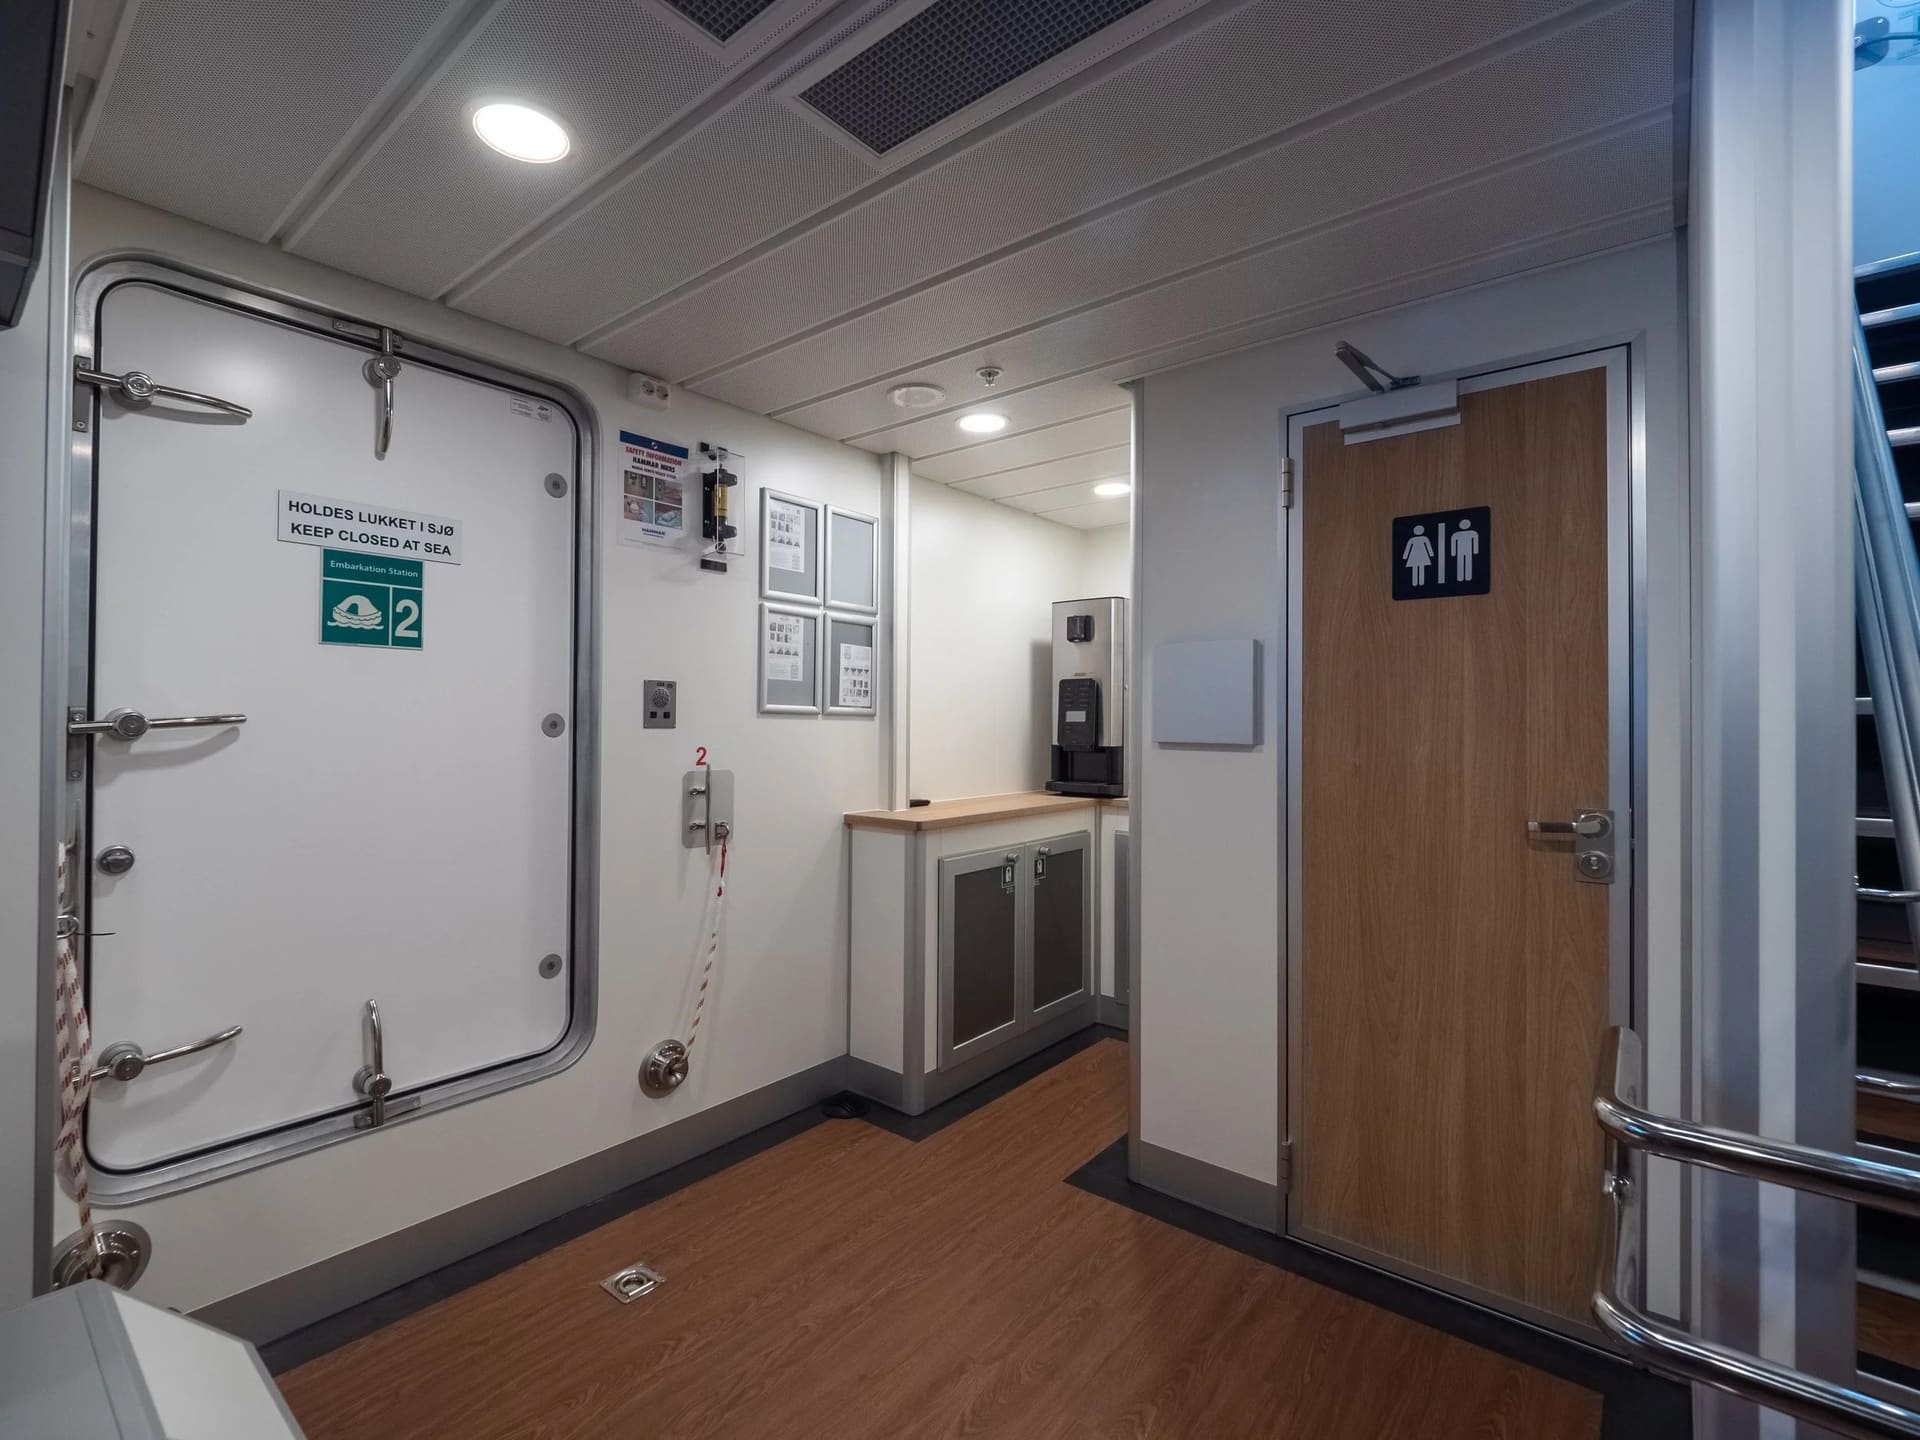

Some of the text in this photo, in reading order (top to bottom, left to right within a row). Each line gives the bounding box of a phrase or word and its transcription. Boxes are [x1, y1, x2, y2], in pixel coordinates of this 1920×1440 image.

[625, 446, 645, 456] SAFETY
[288, 500, 454, 537] HOLDES LUKKET I SJØ
[290, 523, 452, 556] KEEP CLOSED AT SEA
[330, 560, 418, 579] Embarkation Station
[394, 599, 419, 638] 2
[696, 746, 707, 766] 2
